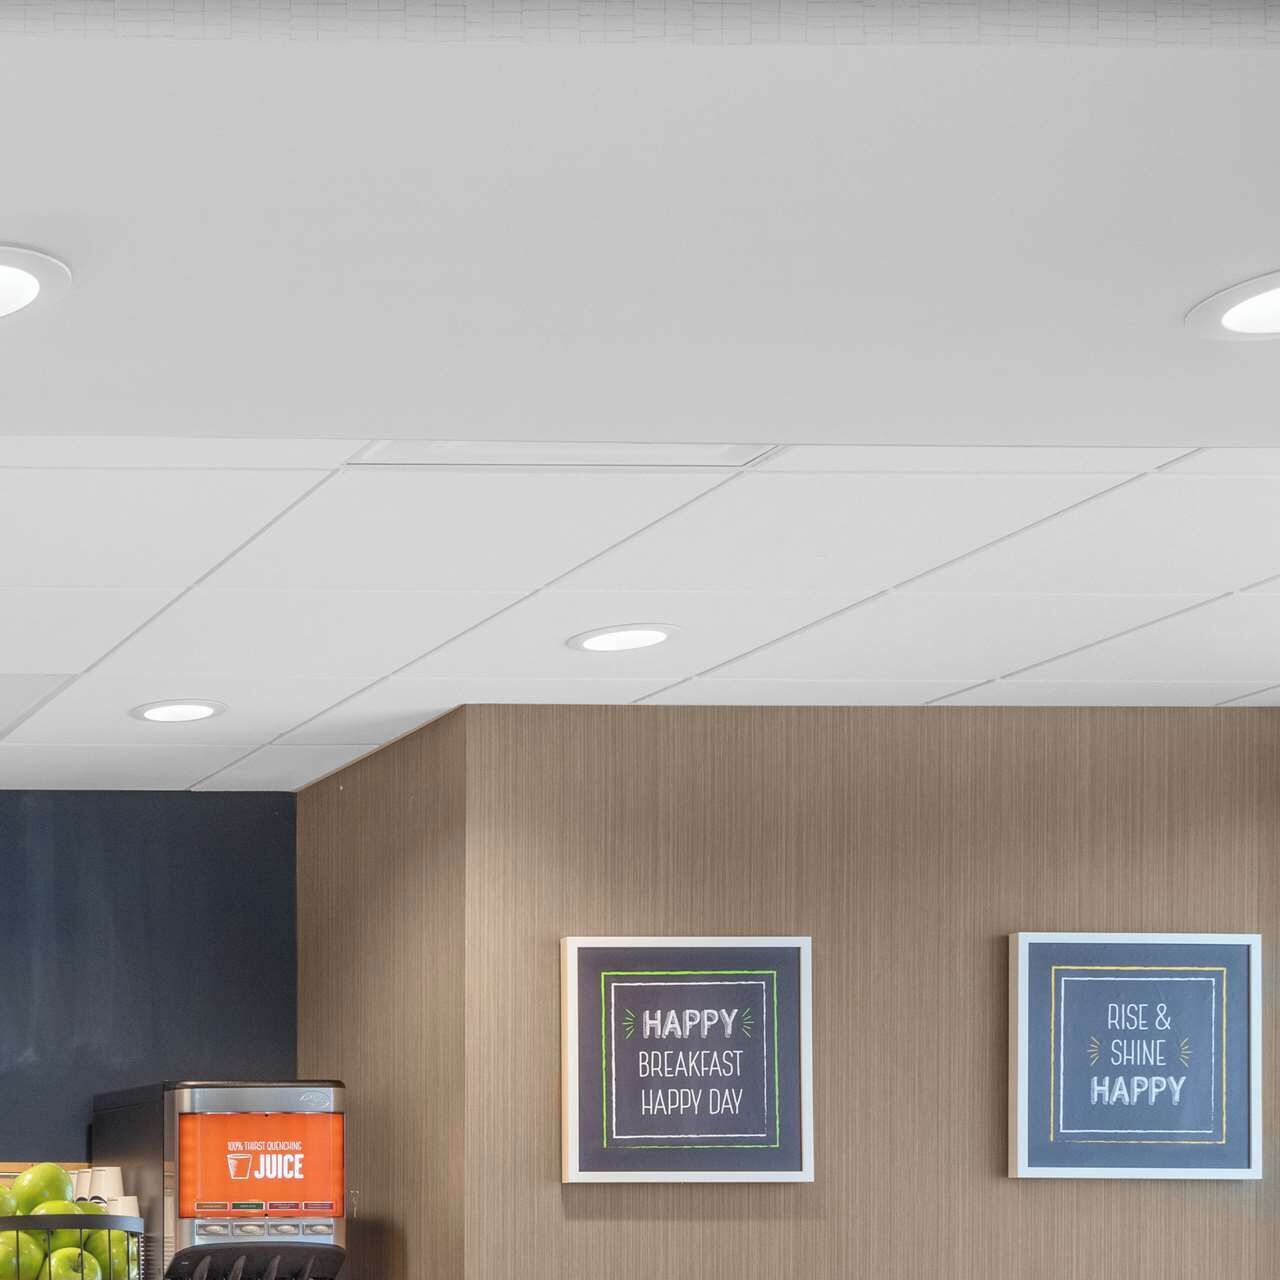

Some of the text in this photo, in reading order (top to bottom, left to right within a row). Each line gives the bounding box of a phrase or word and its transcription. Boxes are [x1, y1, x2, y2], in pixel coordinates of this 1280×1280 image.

[642, 1009, 738, 1039] HAPPY
[1108, 1003, 1171, 1030] RISE &
[639, 1050, 743, 1077] BREAKFAST
[1111, 1039, 1167, 1066] SHINE
[642, 1088, 743, 1115] HAPPY DAY
[1091, 1076, 1186, 1106] HAPPY
[254, 1153, 304, 1179] JUICE
